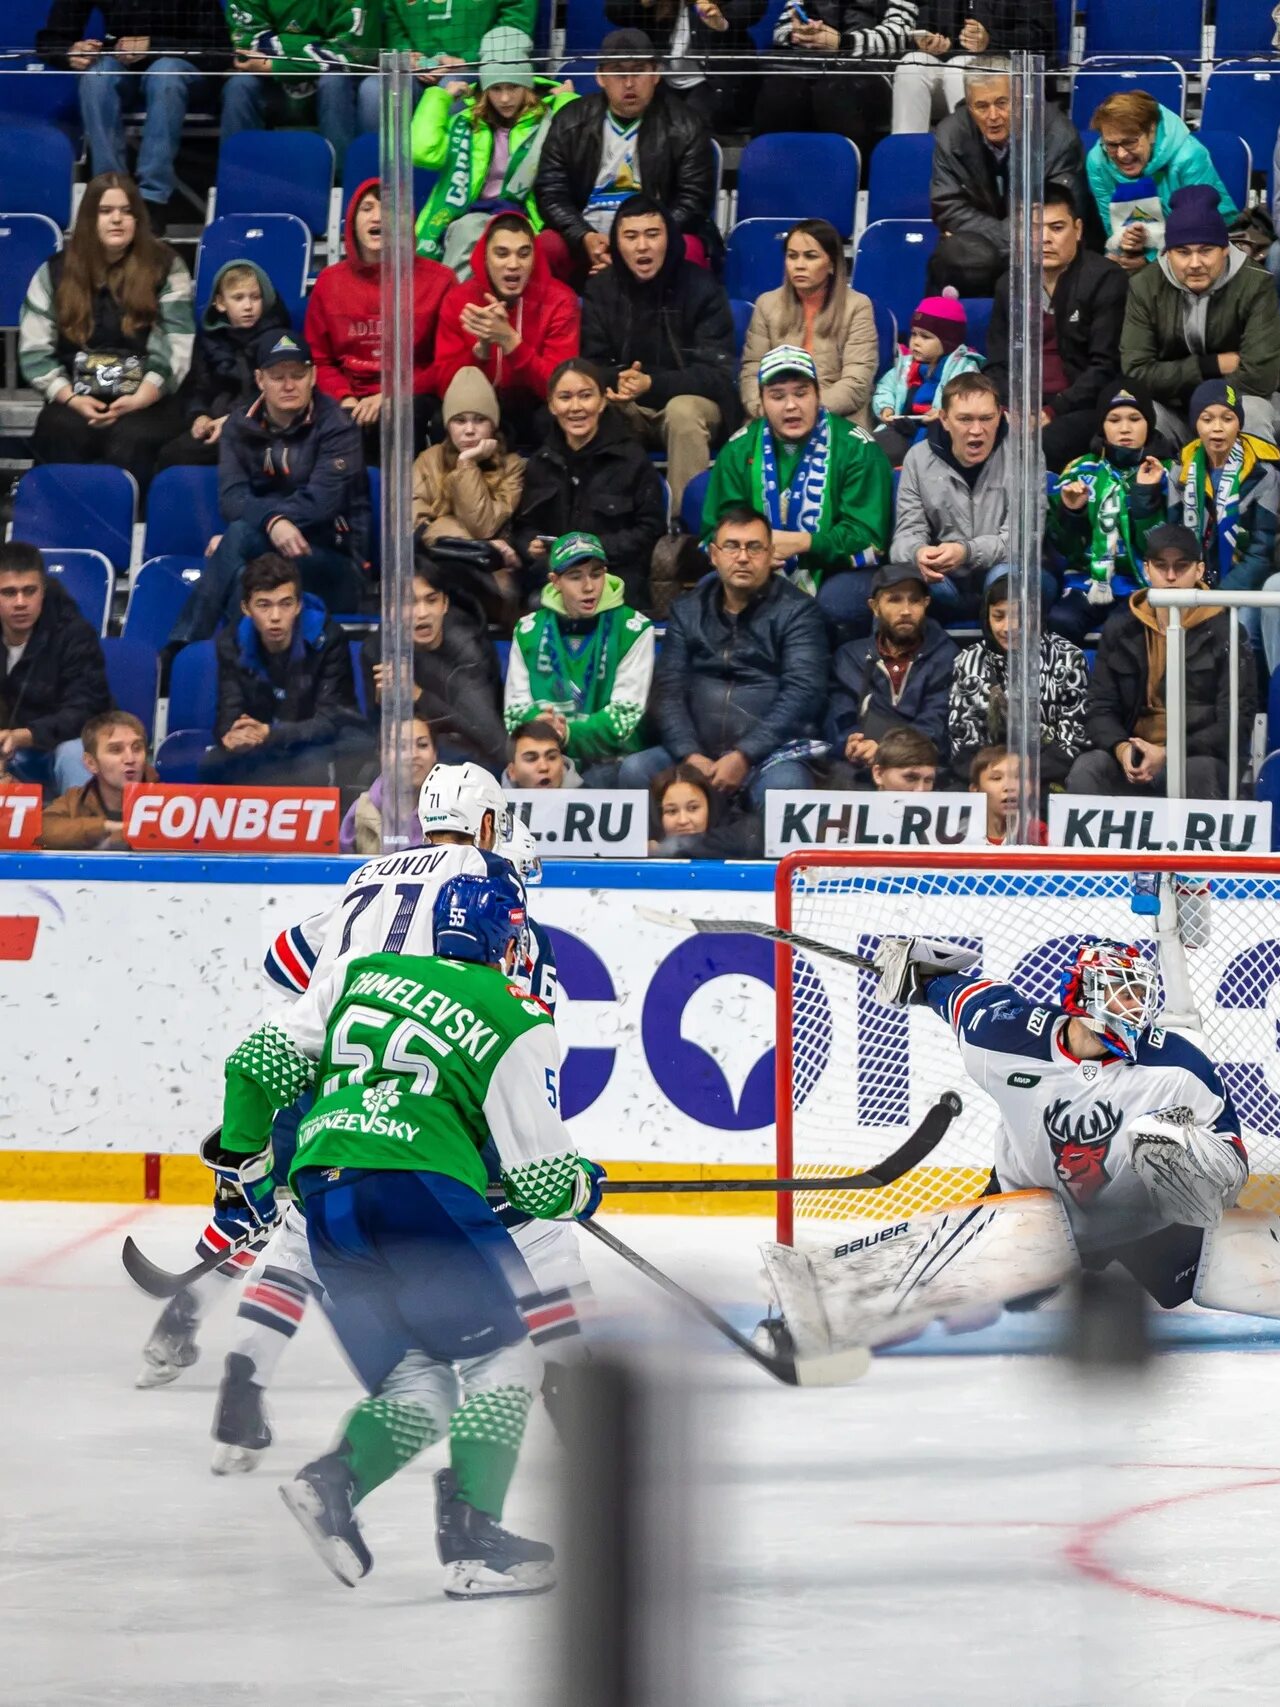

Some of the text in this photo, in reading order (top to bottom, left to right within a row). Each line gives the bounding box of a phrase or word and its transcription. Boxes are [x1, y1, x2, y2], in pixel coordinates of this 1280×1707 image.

[128, 795, 336, 842] FONBET
[430, 793, 440, 808] 71
[508, 793, 632, 842] L.RU
[781, 803, 972, 844] KHL.RU
[1065, 807, 1259, 852] KHL.RU
[354, 850, 449, 886] ETUNOV
[338, 883, 425, 958] 71
[449, 908, 466, 927] 55
[322, 1003, 454, 1098] 55
